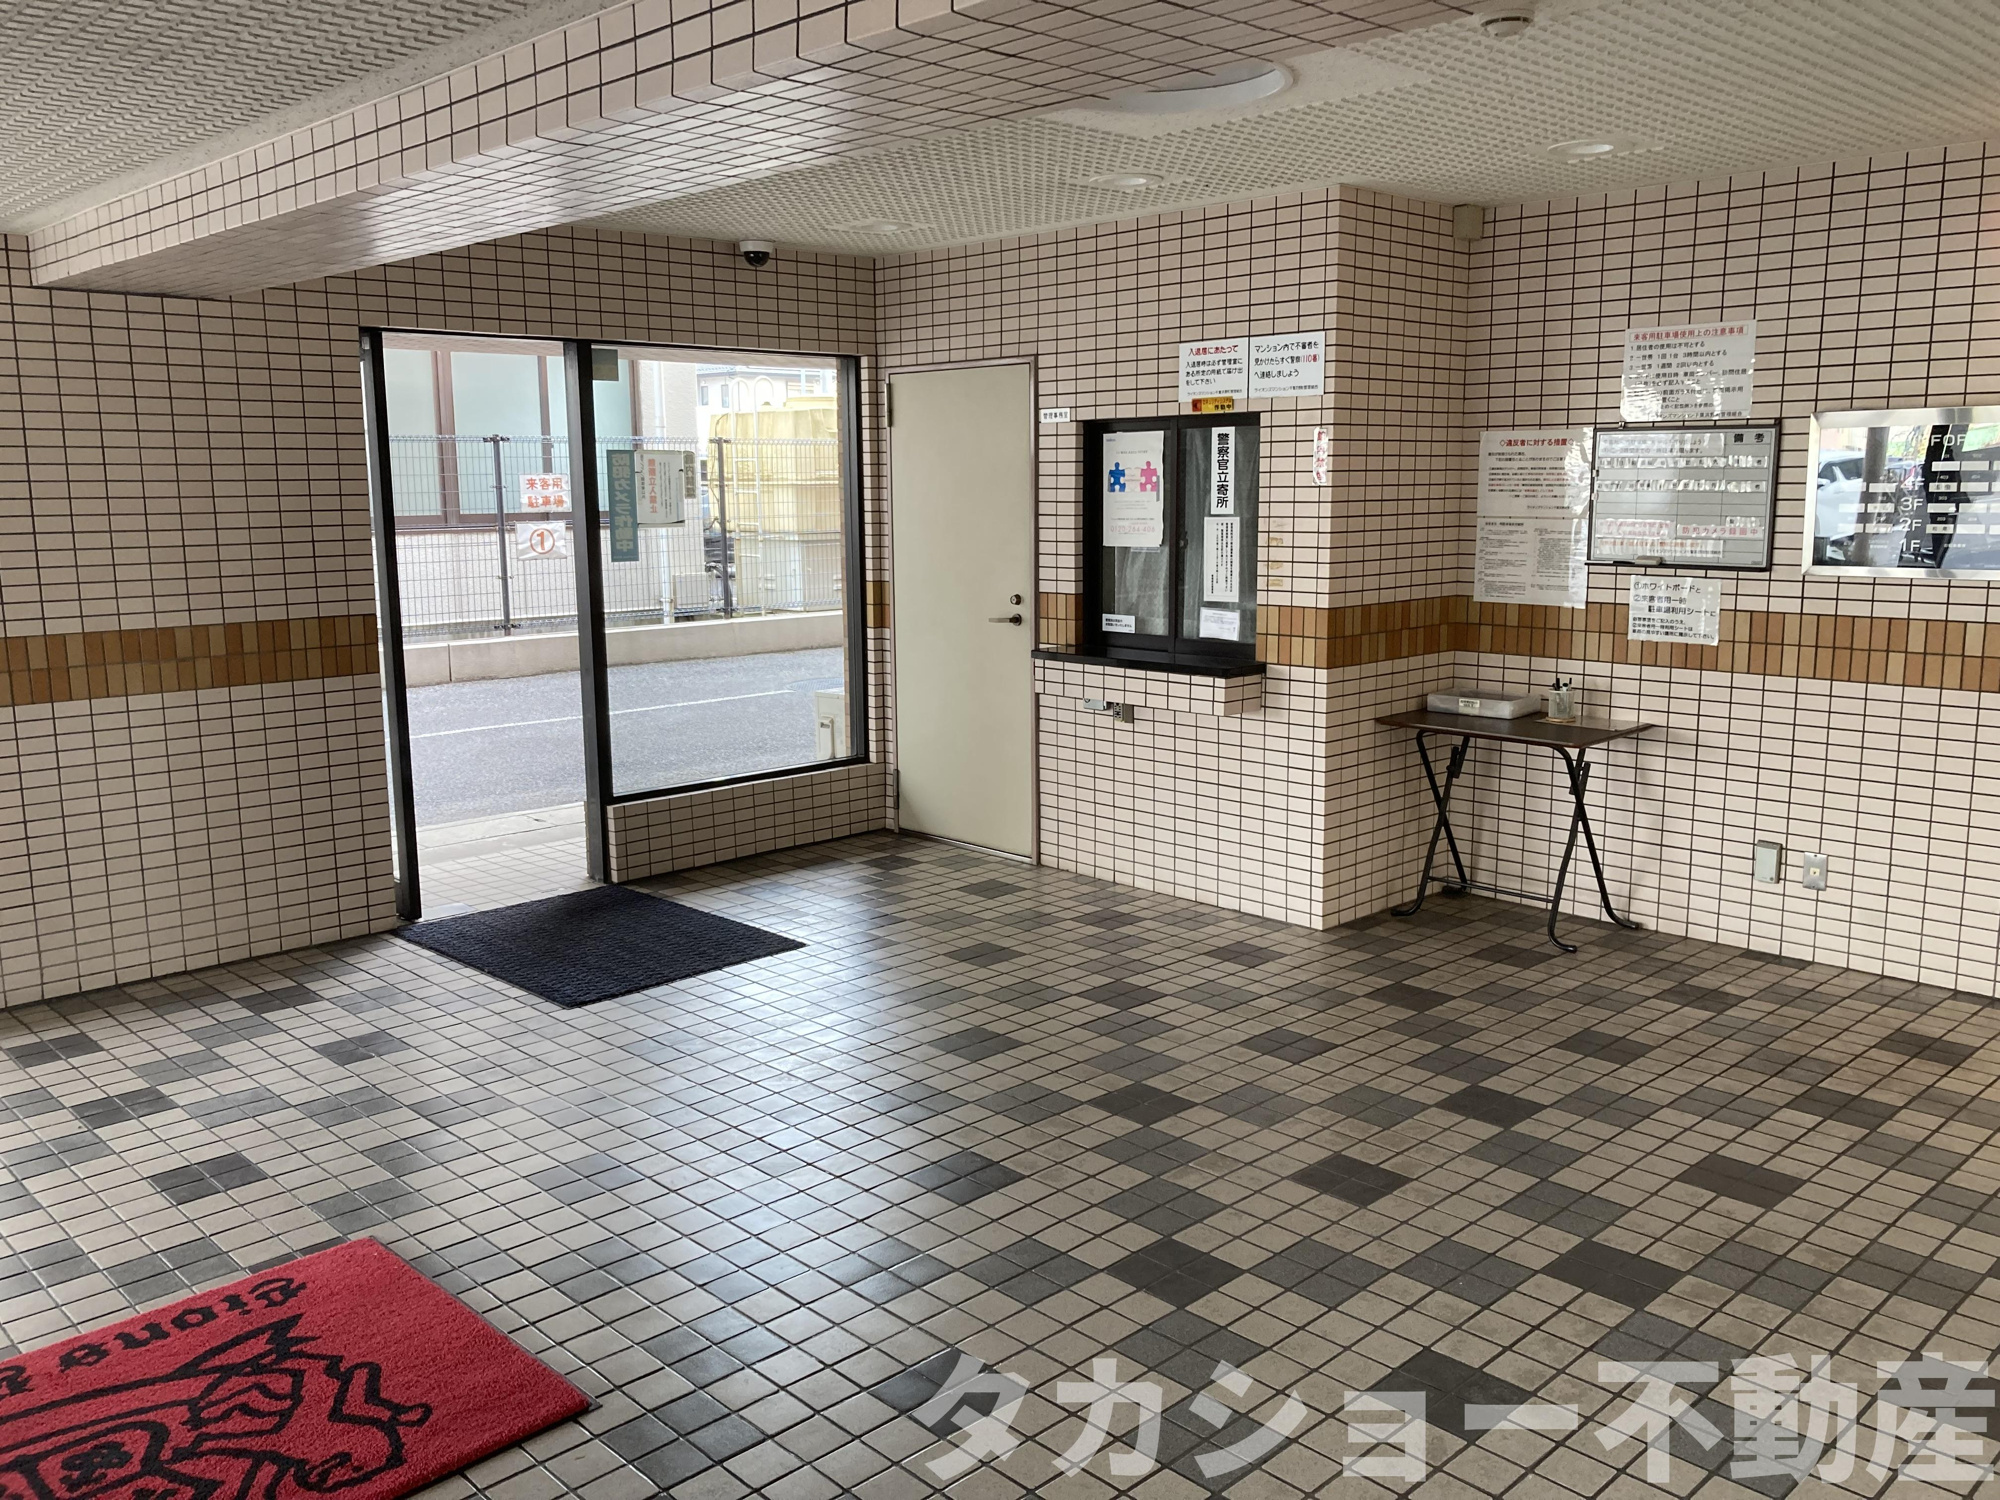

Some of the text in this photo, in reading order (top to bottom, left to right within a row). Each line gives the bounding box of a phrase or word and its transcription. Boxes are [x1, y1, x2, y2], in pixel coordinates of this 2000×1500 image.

[1188, 344, 1239, 356] 入退居にあたって
[1254, 341, 1320, 353] マンション内で不審者を
[1253, 368, 1300, 379] へ連絡しましょう
[1216, 432, 1231, 509] 警察官立寄所
[526, 477, 563, 490] 来客用
[527, 495, 565, 508] 駐車場
[1900, 497, 1923, 511] 3F
[1899, 517, 1922, 531] 2F
[1899, 538, 1921, 552] 1F
